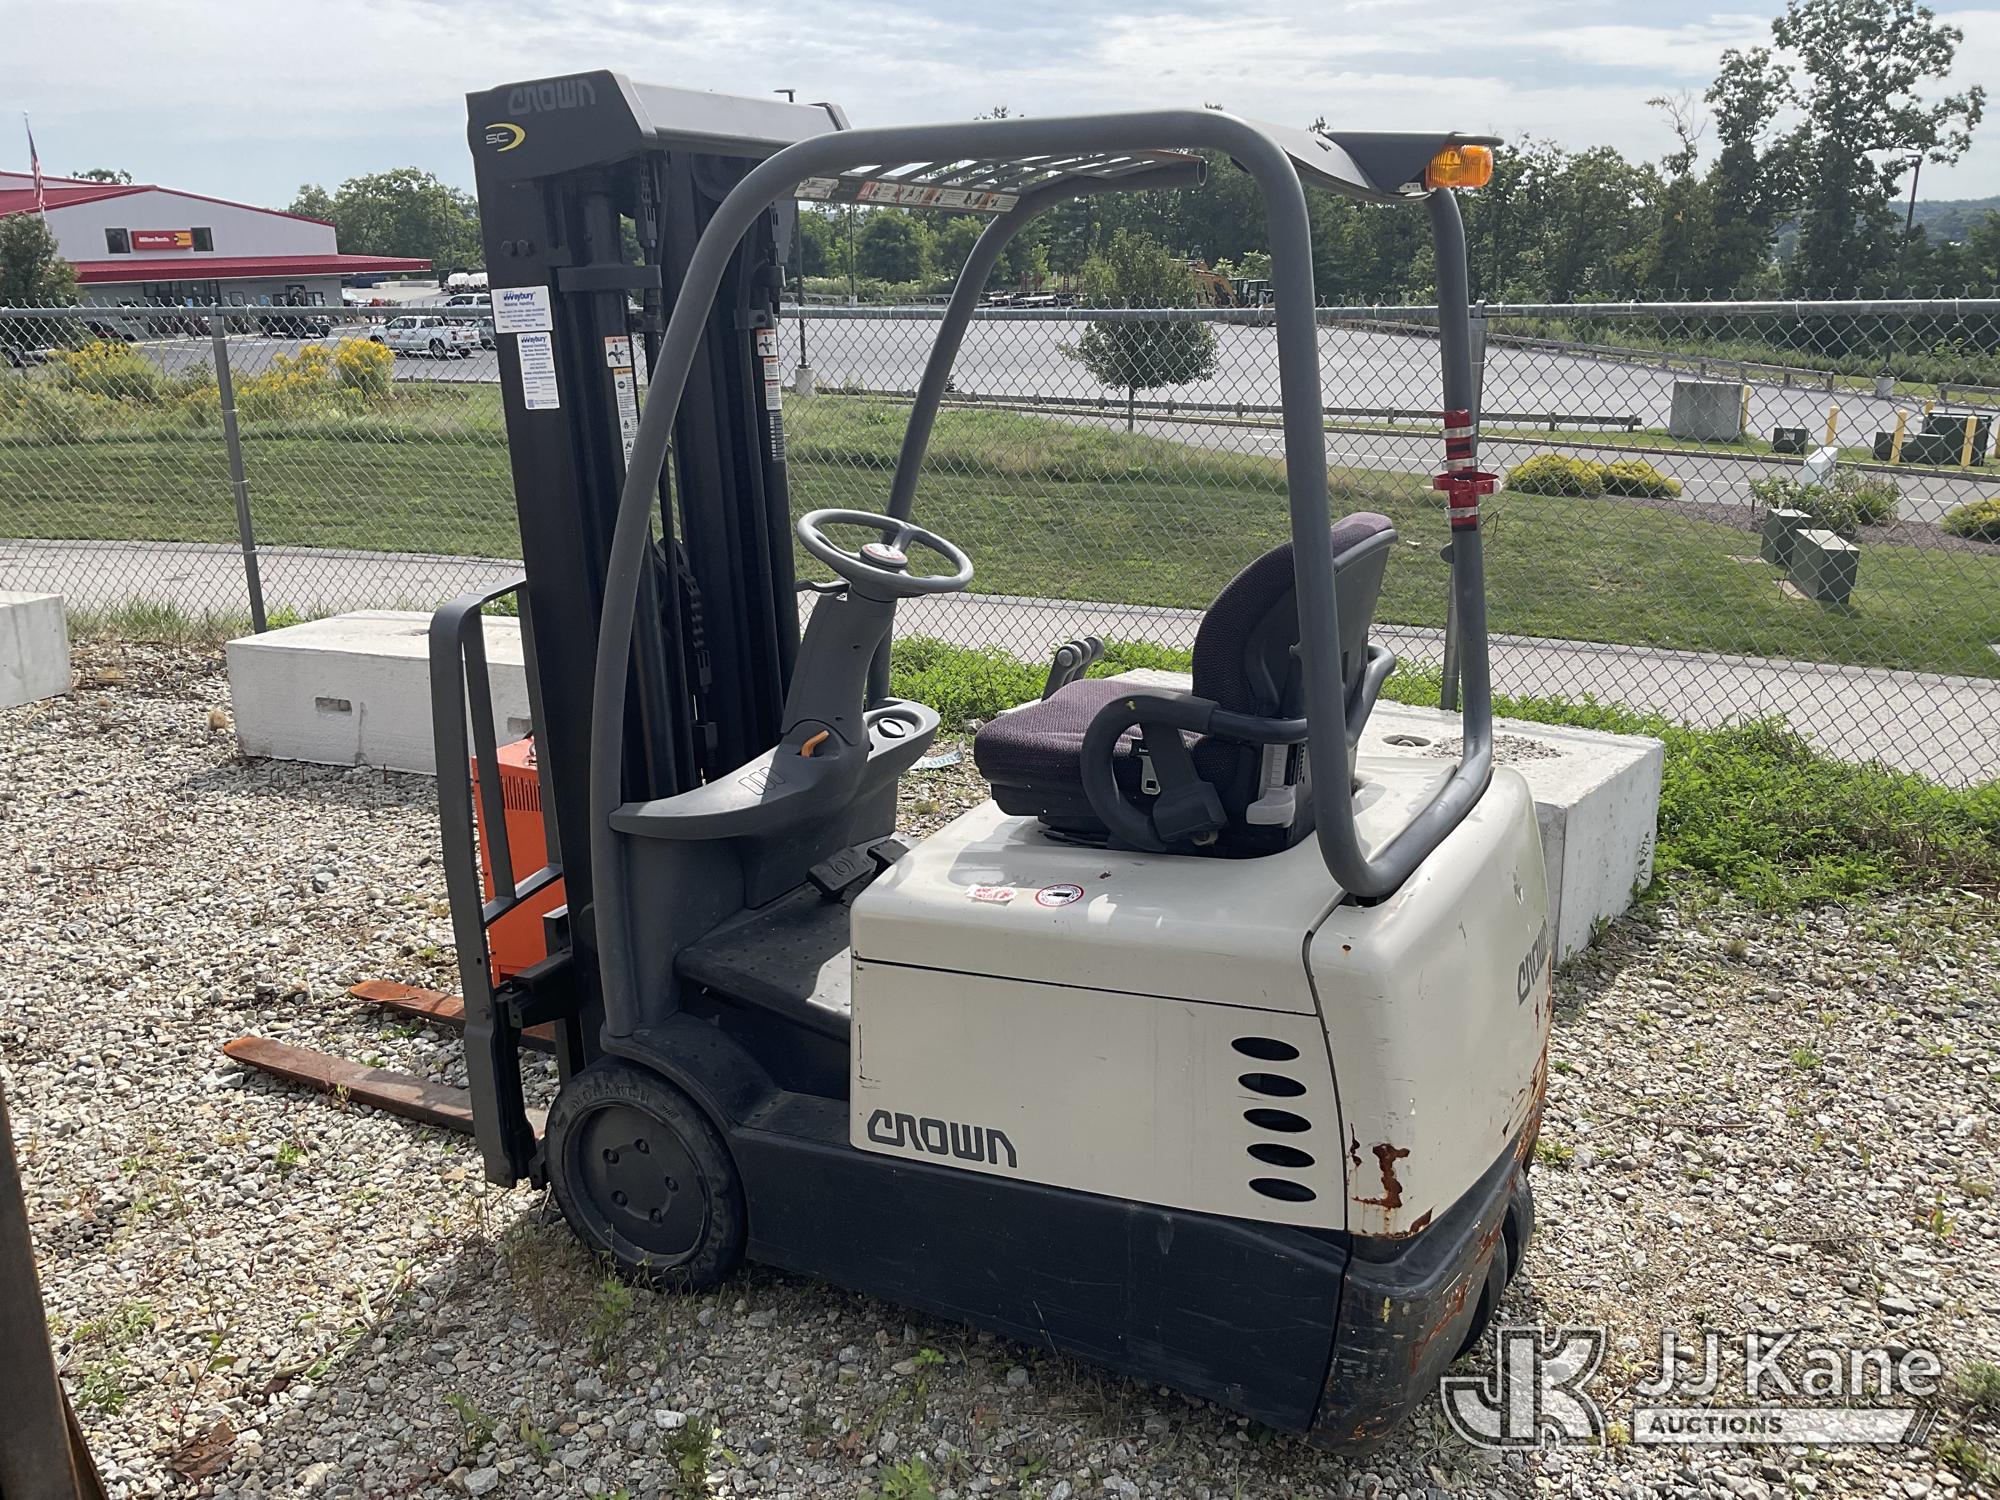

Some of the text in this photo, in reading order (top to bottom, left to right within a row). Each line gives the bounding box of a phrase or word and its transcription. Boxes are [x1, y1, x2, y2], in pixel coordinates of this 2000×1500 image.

[508, 79, 596, 115] CROWN
[485, 132, 509, 145] SC
[867, 1109, 1018, 1168] CROWN
